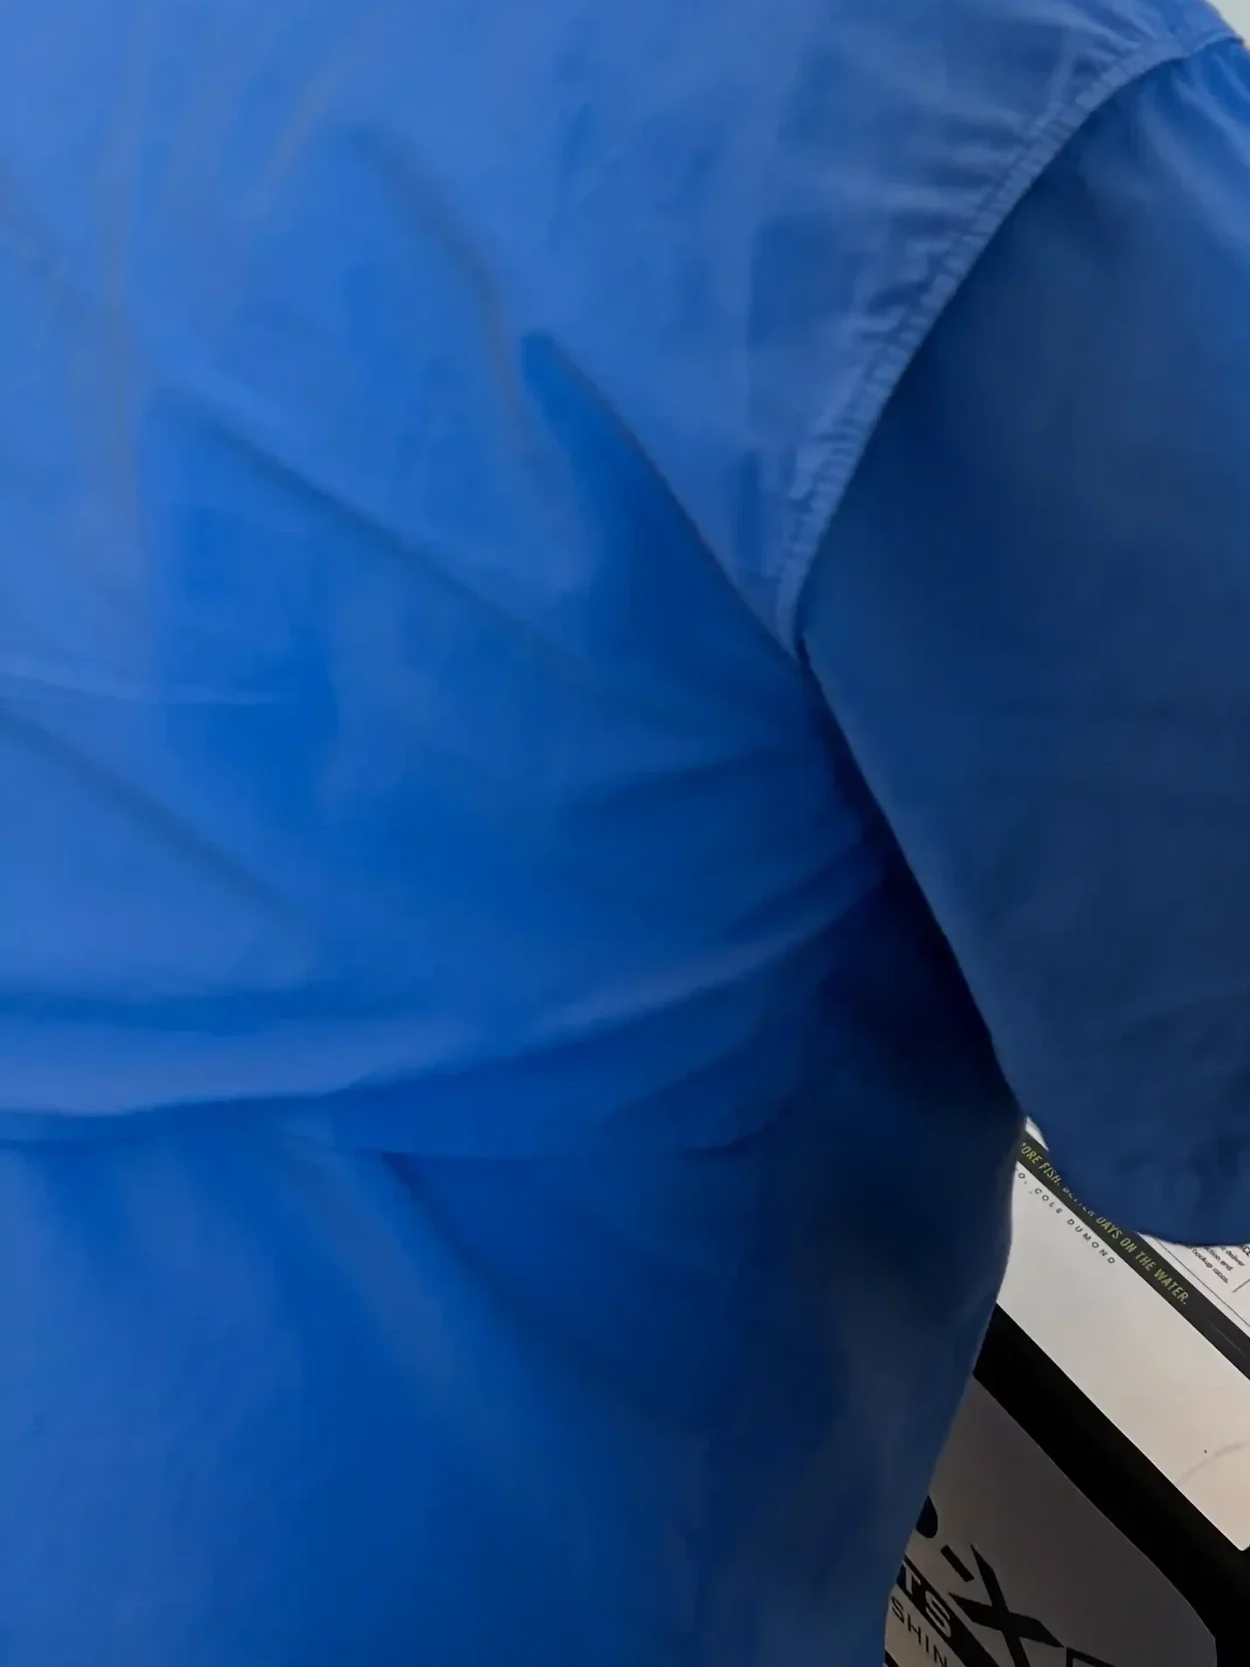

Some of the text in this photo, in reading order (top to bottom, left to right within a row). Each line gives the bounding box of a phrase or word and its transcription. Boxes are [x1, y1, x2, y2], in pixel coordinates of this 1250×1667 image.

[1034, 1188, 1063, 1214] COLE
[1067, 1219, 1115, 1264] DUMOND
[1120, 1237, 1137, 1253] ON
[1135, 1251, 1157, 1271] THE
[1153, 1268, 1189, 1305] WATER.
